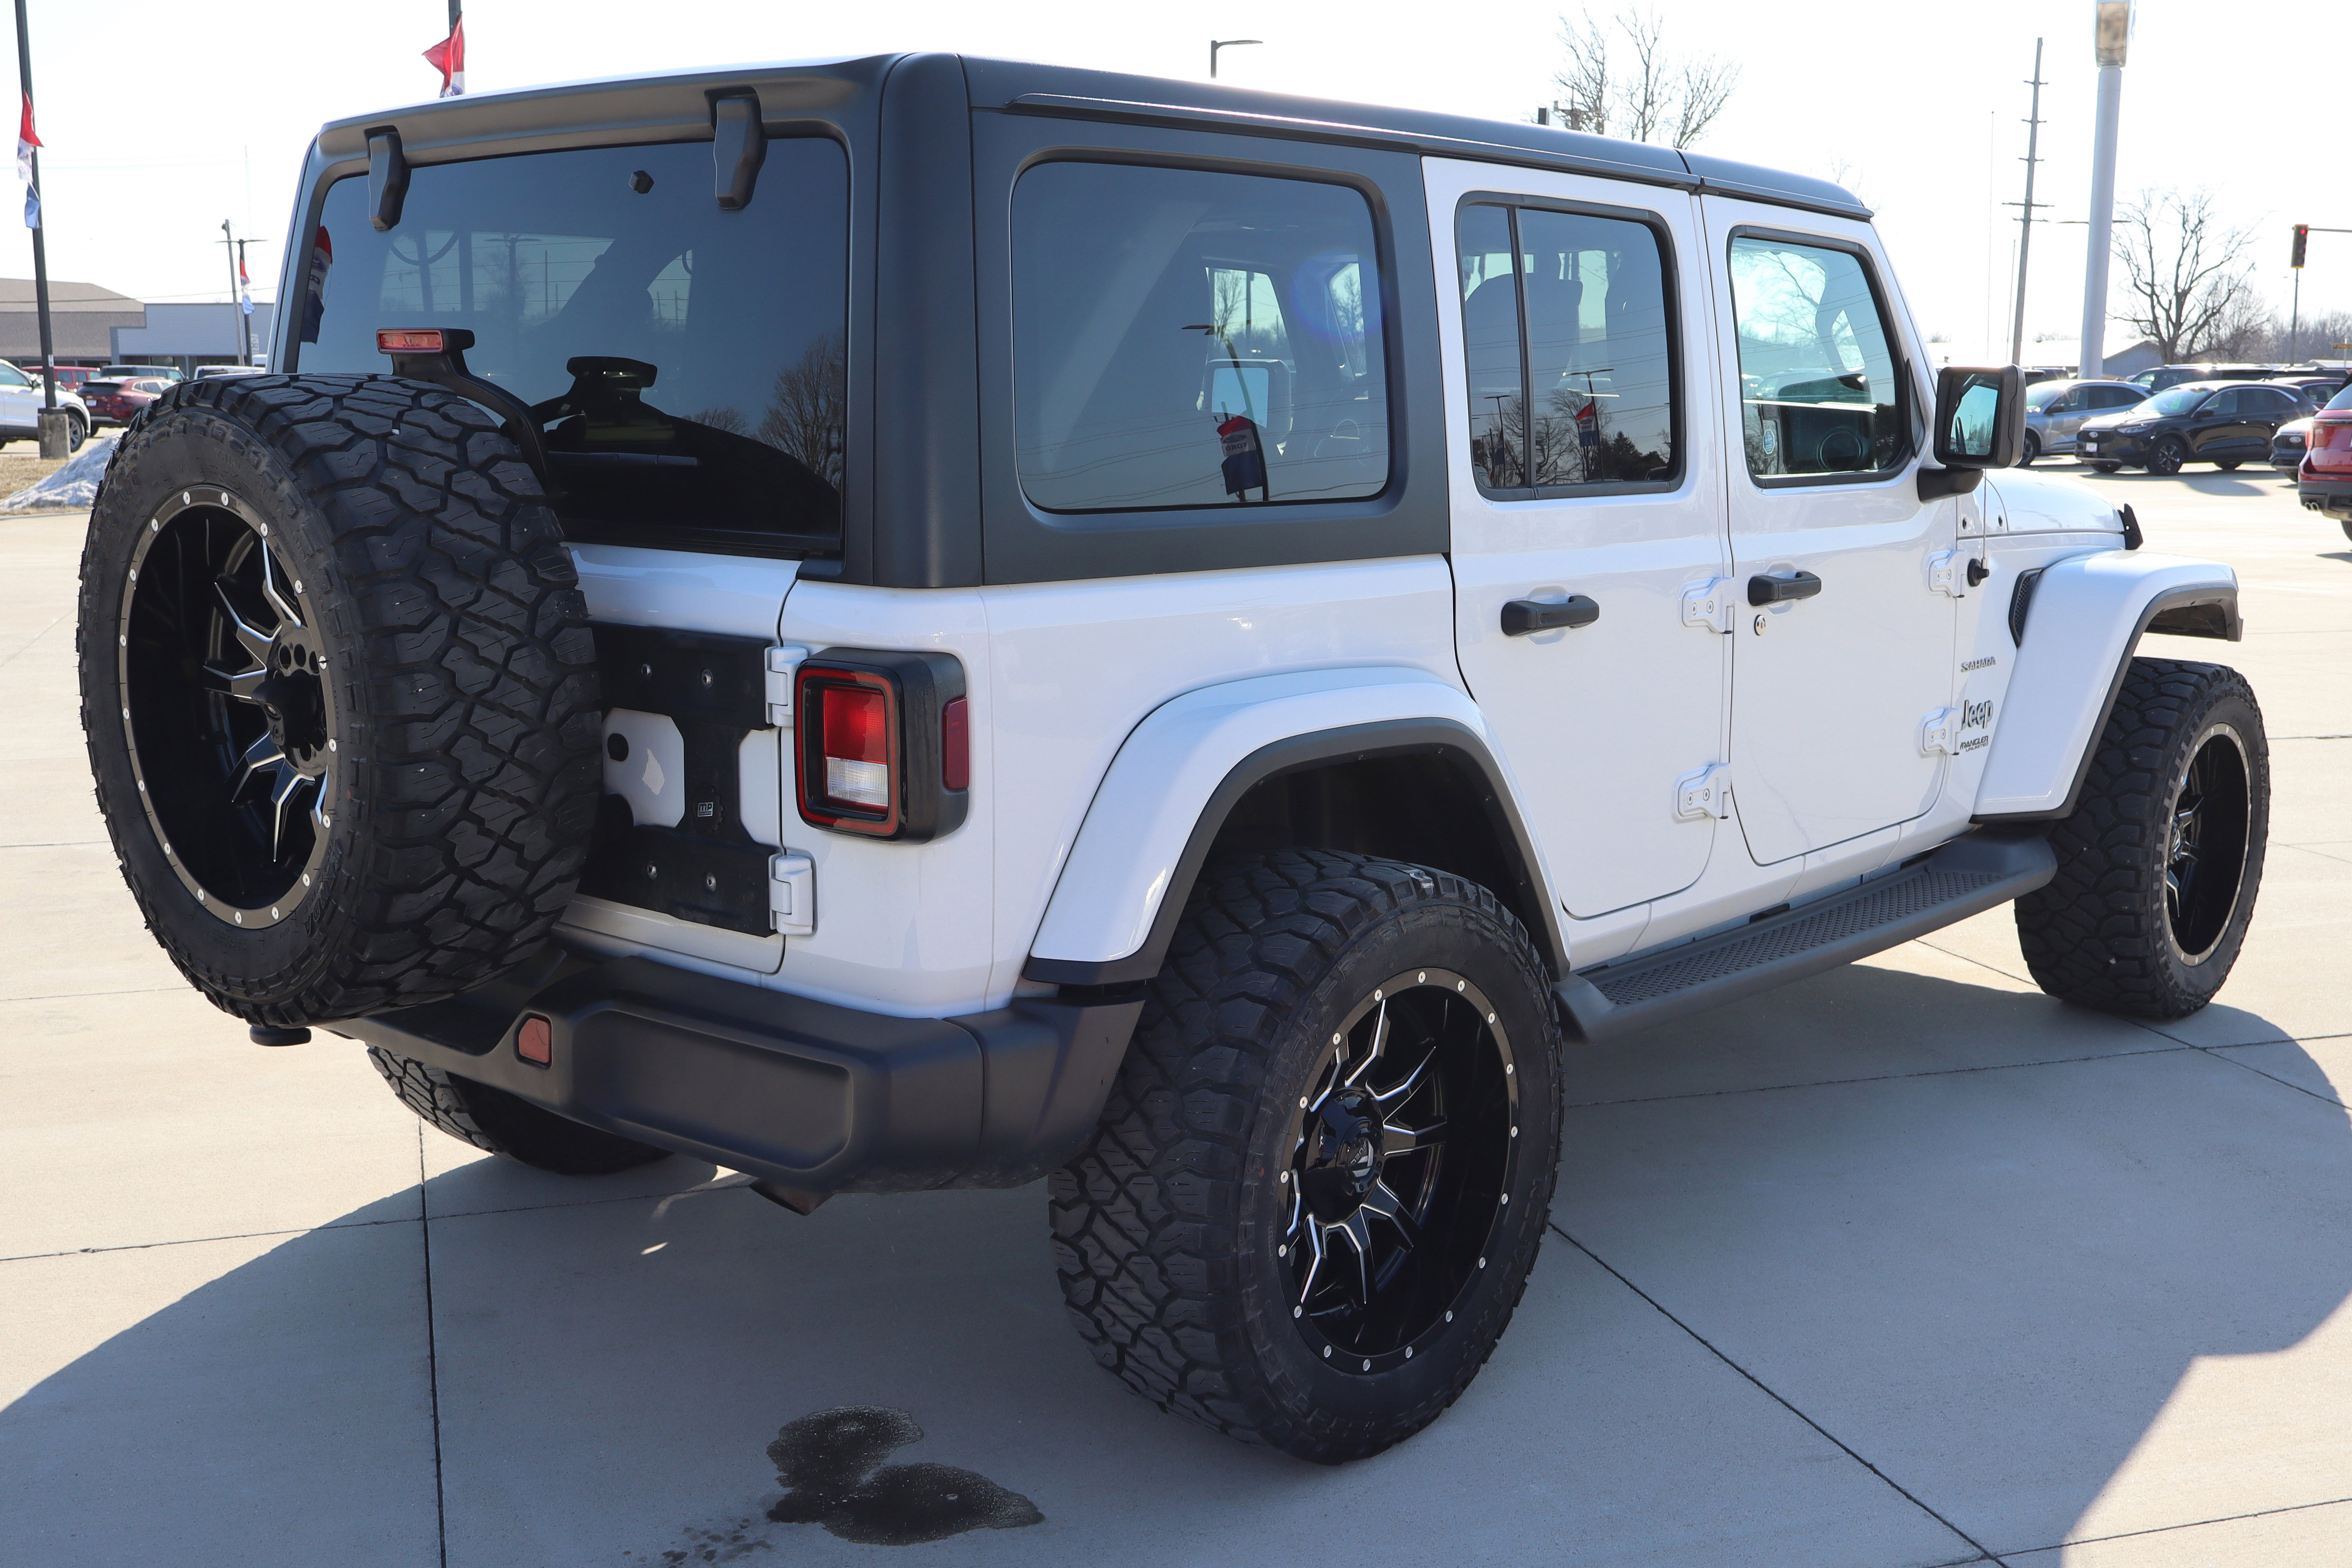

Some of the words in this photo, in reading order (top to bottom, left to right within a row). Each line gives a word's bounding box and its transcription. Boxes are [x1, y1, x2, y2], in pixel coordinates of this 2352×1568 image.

[1961, 656, 1996, 673] SAHARA
[1960, 699, 1993, 729] Jeep
[1966, 742, 1988, 752] UNLIMITED
[1350, 1141, 1366, 1164] FUEL
